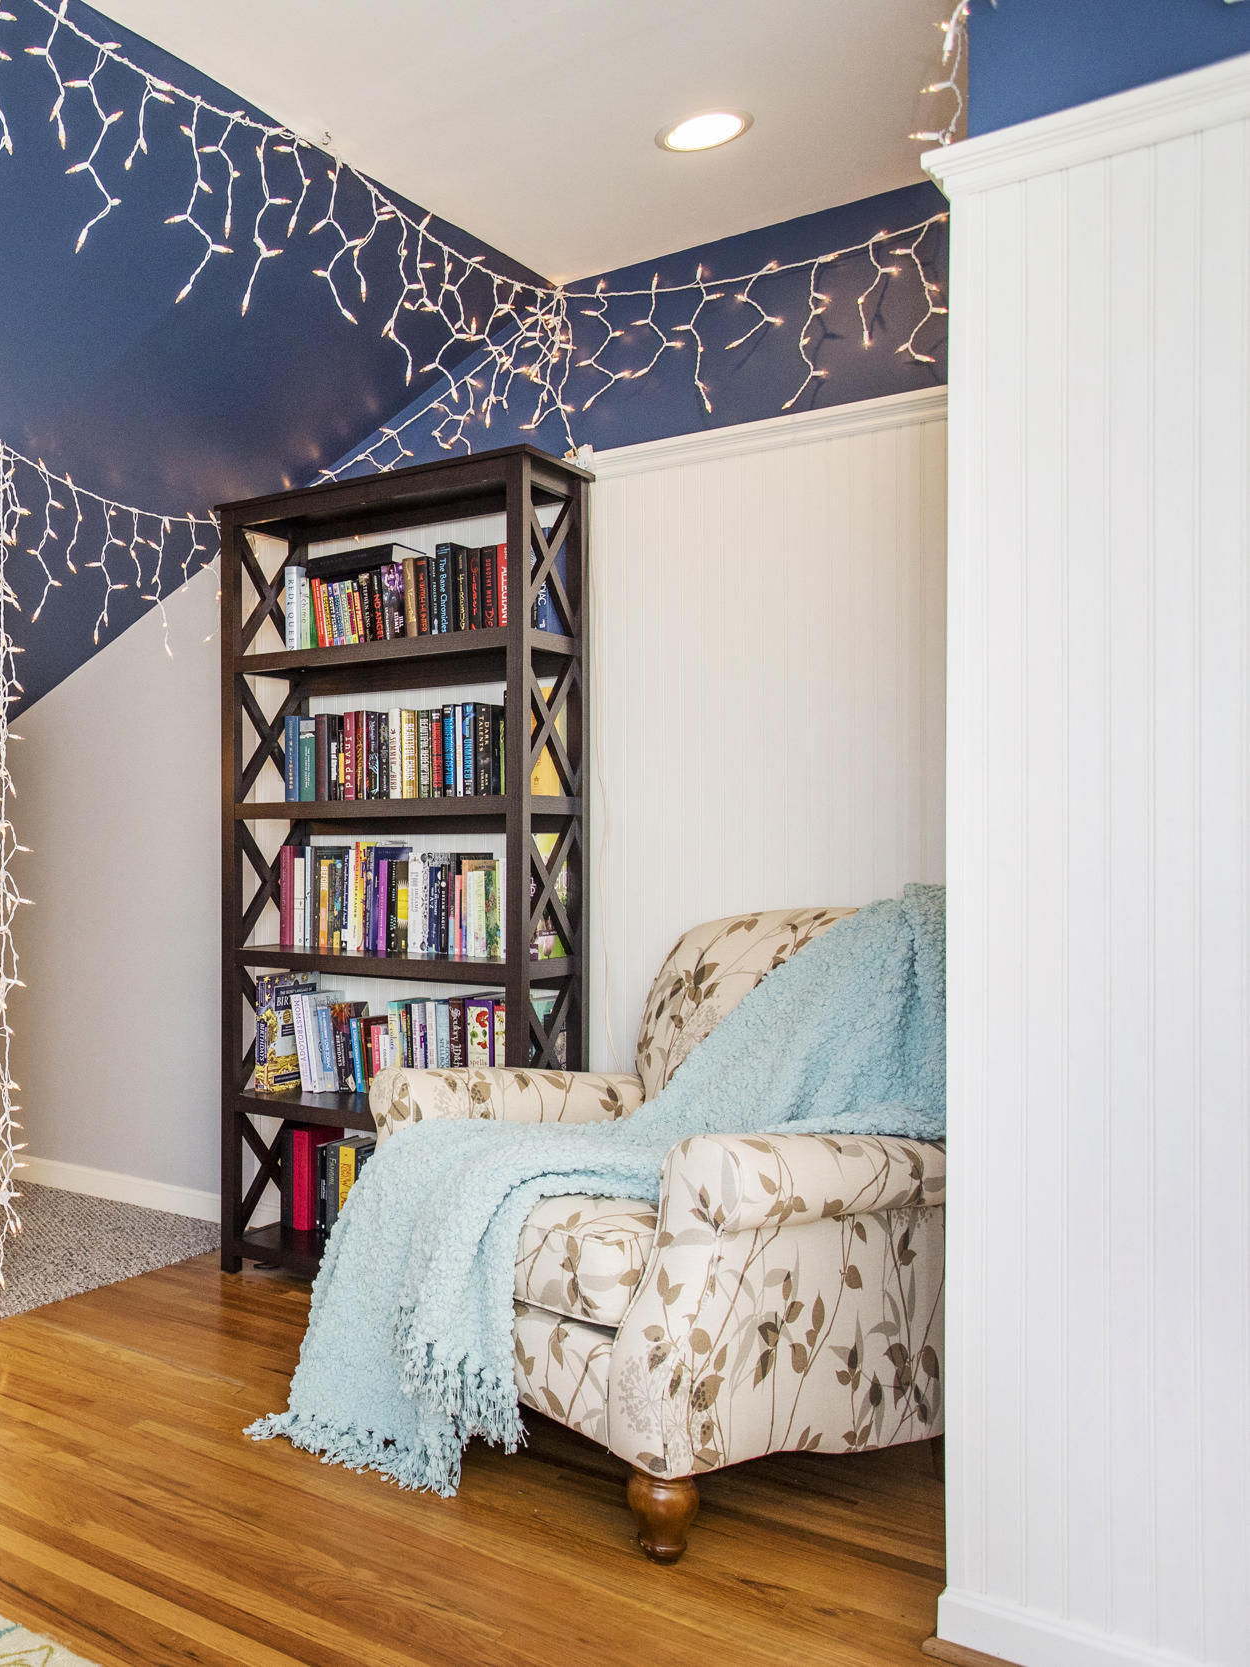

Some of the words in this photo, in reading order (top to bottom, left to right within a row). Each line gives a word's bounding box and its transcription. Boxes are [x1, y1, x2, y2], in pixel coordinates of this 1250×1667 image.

[439, 557, 447, 573] The
[485, 558, 493, 588] DOROTHY
[287, 579, 295, 600] RED
[439, 573, 447, 593] Bane
[485, 589, 493, 607] MUST
[537, 581, 547, 606] DIAC
[373, 594, 382, 609] NO
[440, 593, 449, 633] Chronicles
[287, 612, 295, 651] QUEEN
[375, 611, 385, 641] ANGEL
[404, 723, 415, 757] BEAUTIFUL
[420, 718, 430, 749] BEAUTIFUL
[344, 736, 354, 788] Invaded
[389, 737, 397, 765] SUMMER
[463, 738, 473, 779] UNMARKED
[404, 759, 415, 781] CHAOS
[420, 749, 430, 785] REDEMPTION
[445, 753, 455, 785] DECEPTION
[389, 774, 398, 791] BIRD
[320, 866, 329, 891] BEFORE
[341, 911, 349, 926] Angels
[258, 1022, 266, 1062] BIRTHDAYS
[293, 1000, 308, 1062] MOMSTROLOGY
[334, 1035, 343, 1067] BIRTHDAYS
[328, 1157, 338, 1185] FANGIRL
